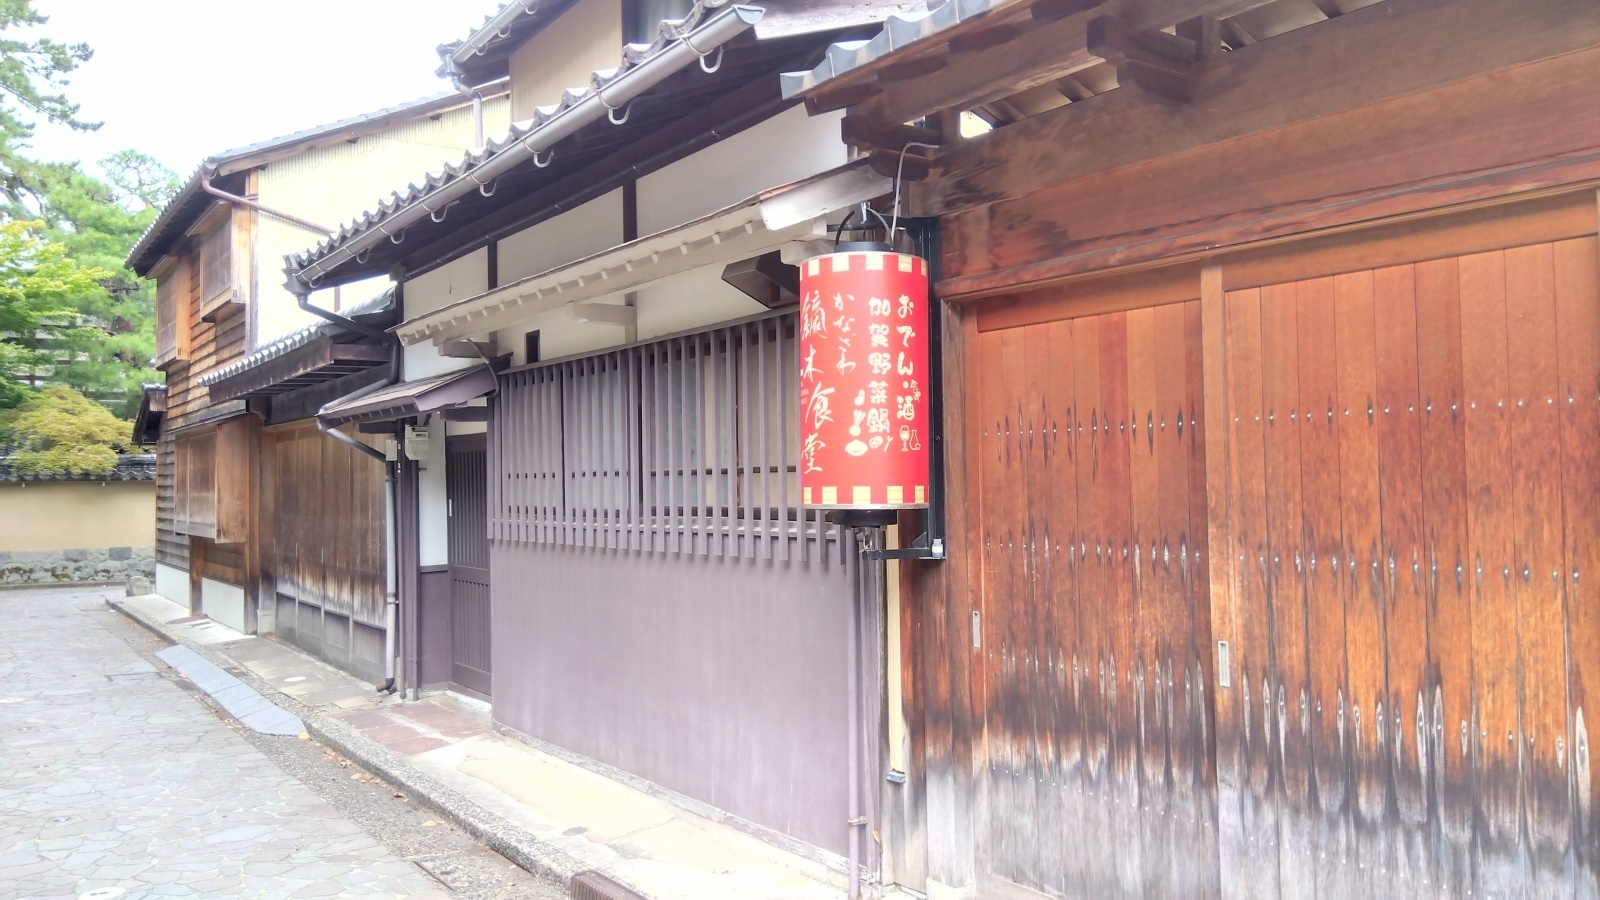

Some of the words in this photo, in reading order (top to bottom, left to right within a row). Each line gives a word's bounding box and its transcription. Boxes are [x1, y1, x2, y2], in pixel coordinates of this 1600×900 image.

[866, 296, 892, 434] 加賀野菜鍋
